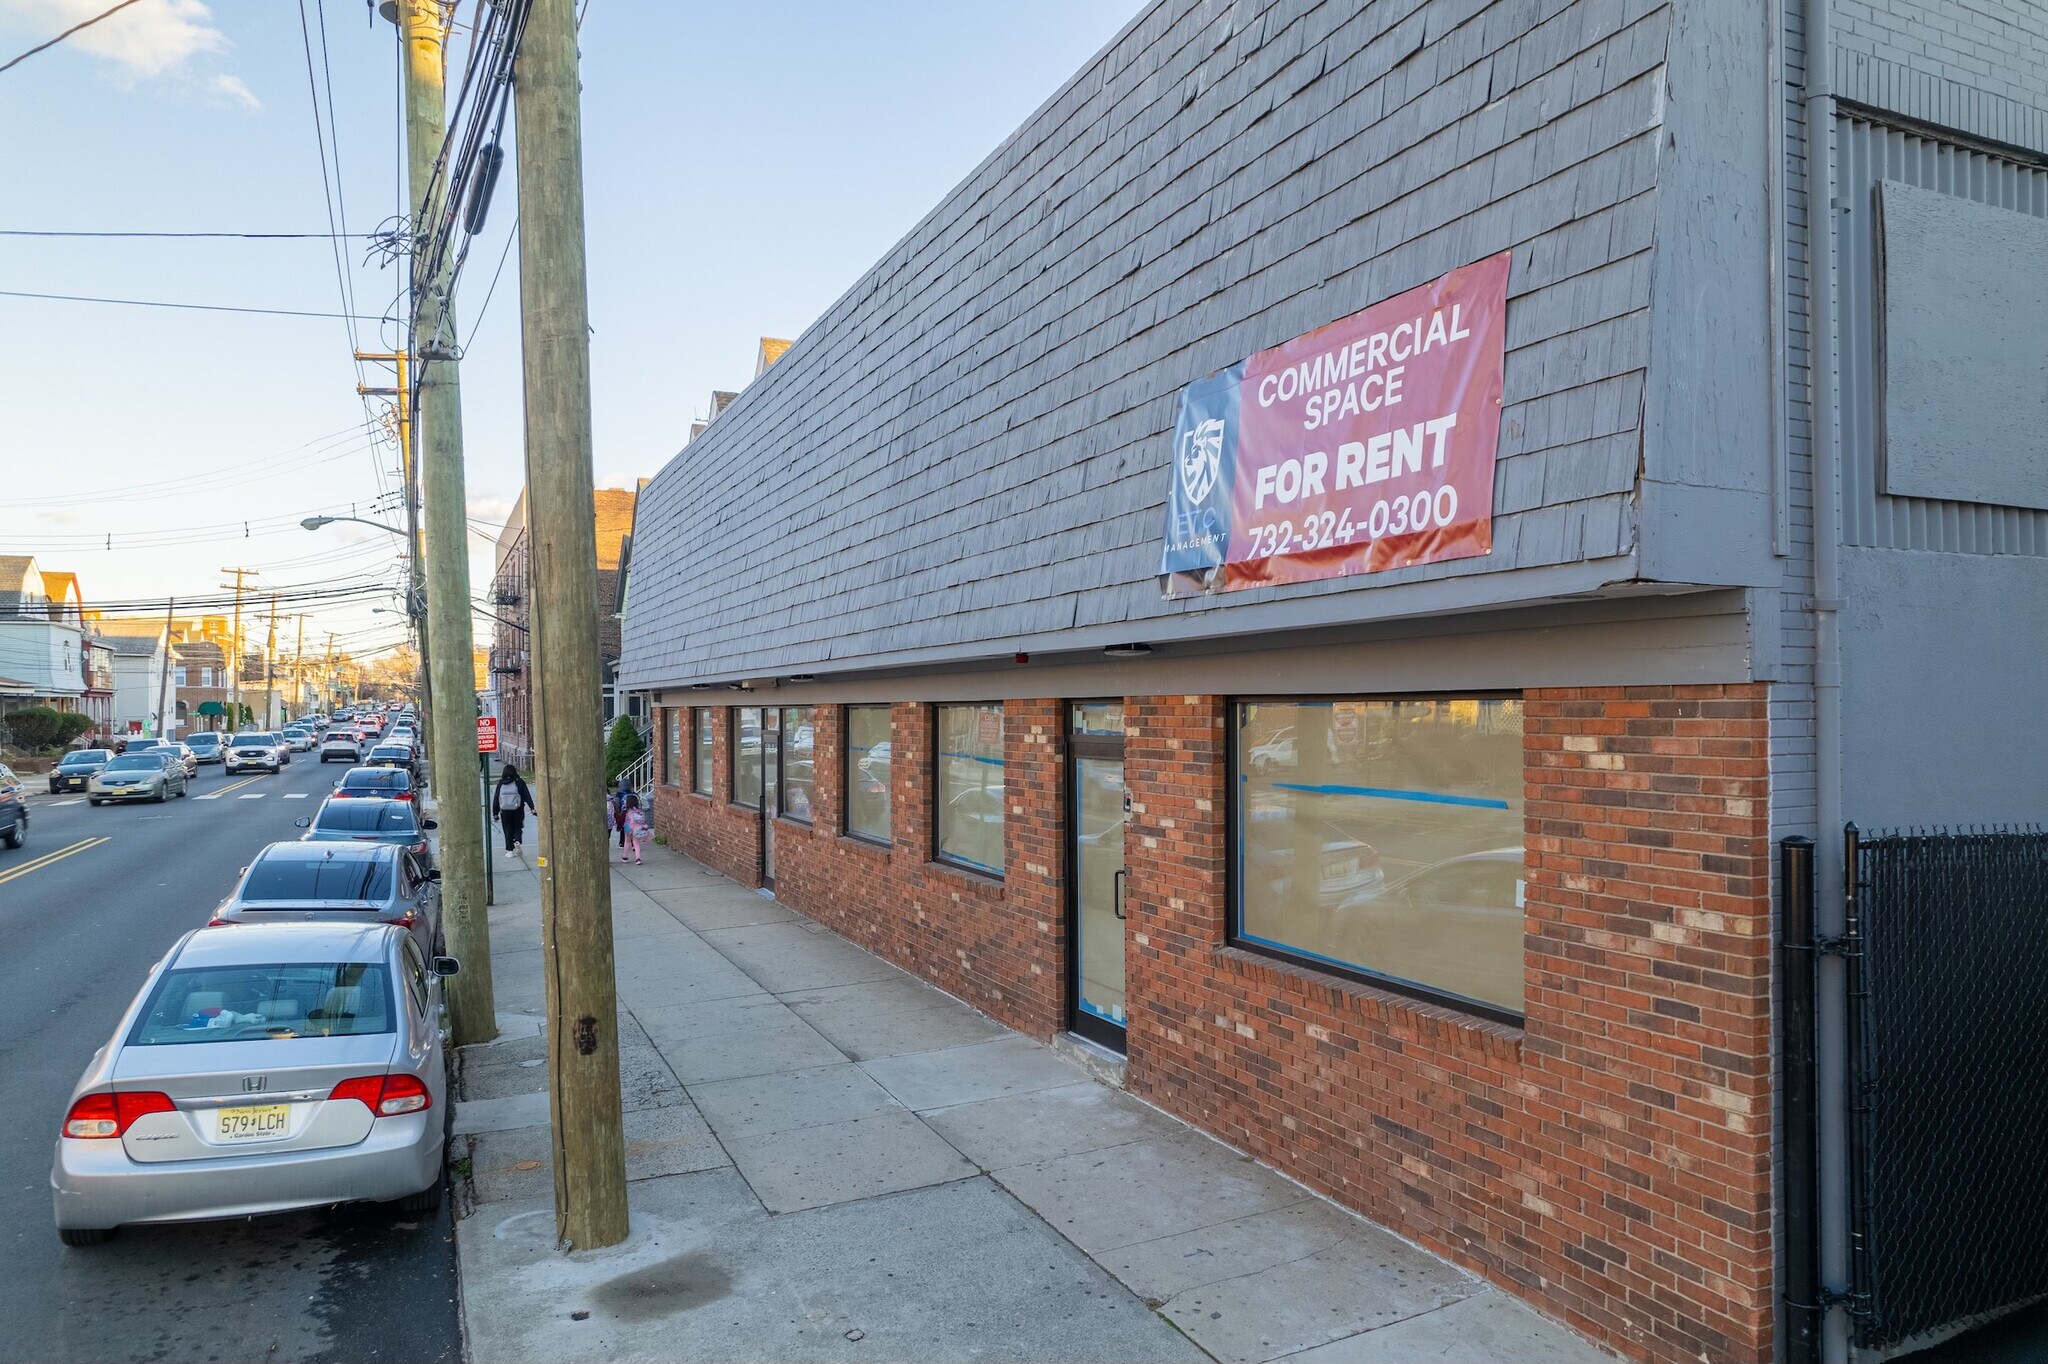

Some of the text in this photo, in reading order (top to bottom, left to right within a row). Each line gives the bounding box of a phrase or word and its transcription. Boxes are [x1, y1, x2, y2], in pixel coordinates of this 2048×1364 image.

[1258, 303, 1471, 408] COMMERCIAL
[1303, 365, 1406, 430] SPACE
[1254, 412, 1458, 511] FOR RENT
[1163, 532, 1228, 553] MANAGEMENT
[1176, 506, 1217, 536] ETC
[1246, 484, 1459, 560] 732-324-0300
